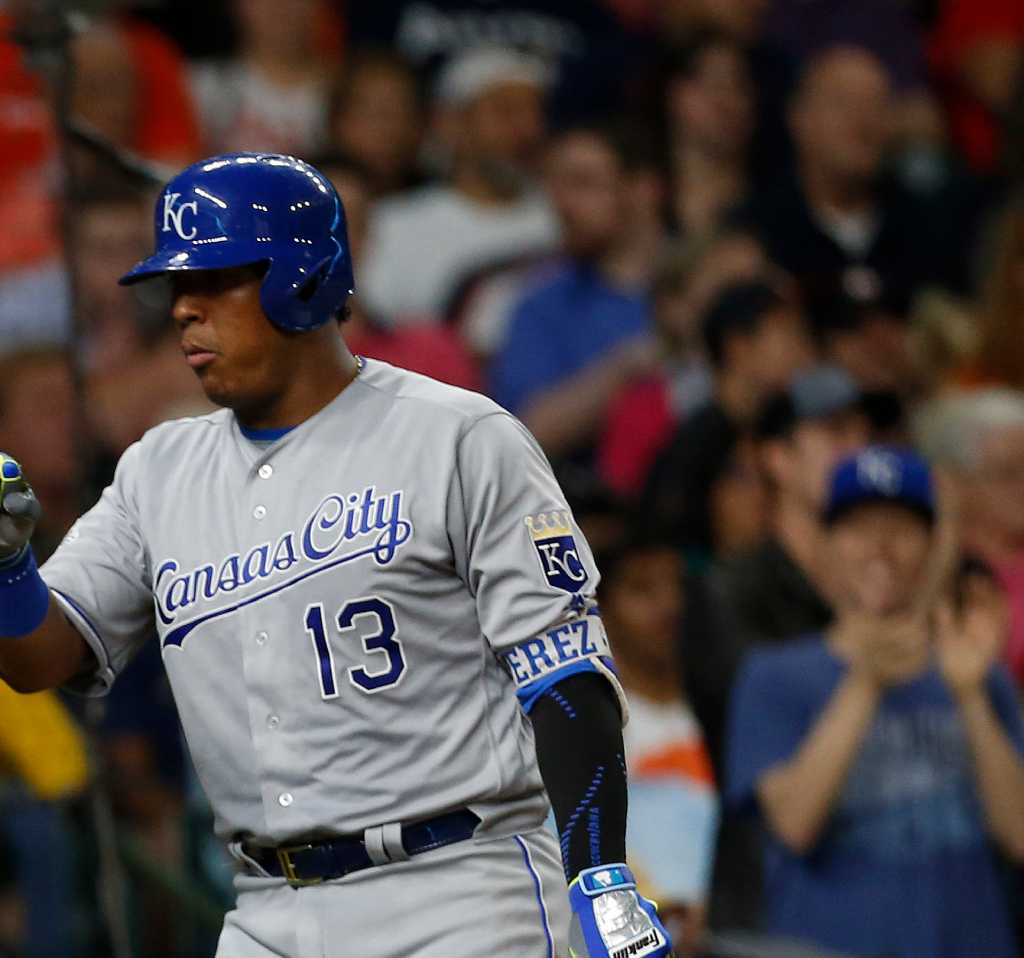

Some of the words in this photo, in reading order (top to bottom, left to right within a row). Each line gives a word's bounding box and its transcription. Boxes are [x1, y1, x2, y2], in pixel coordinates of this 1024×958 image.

[161, 192, 198, 241] KC
[153, 531, 298, 626] Kansas
[301, 485, 414, 567] City
[538, 542, 586, 582] KC
[303, 596, 408, 700] 13
